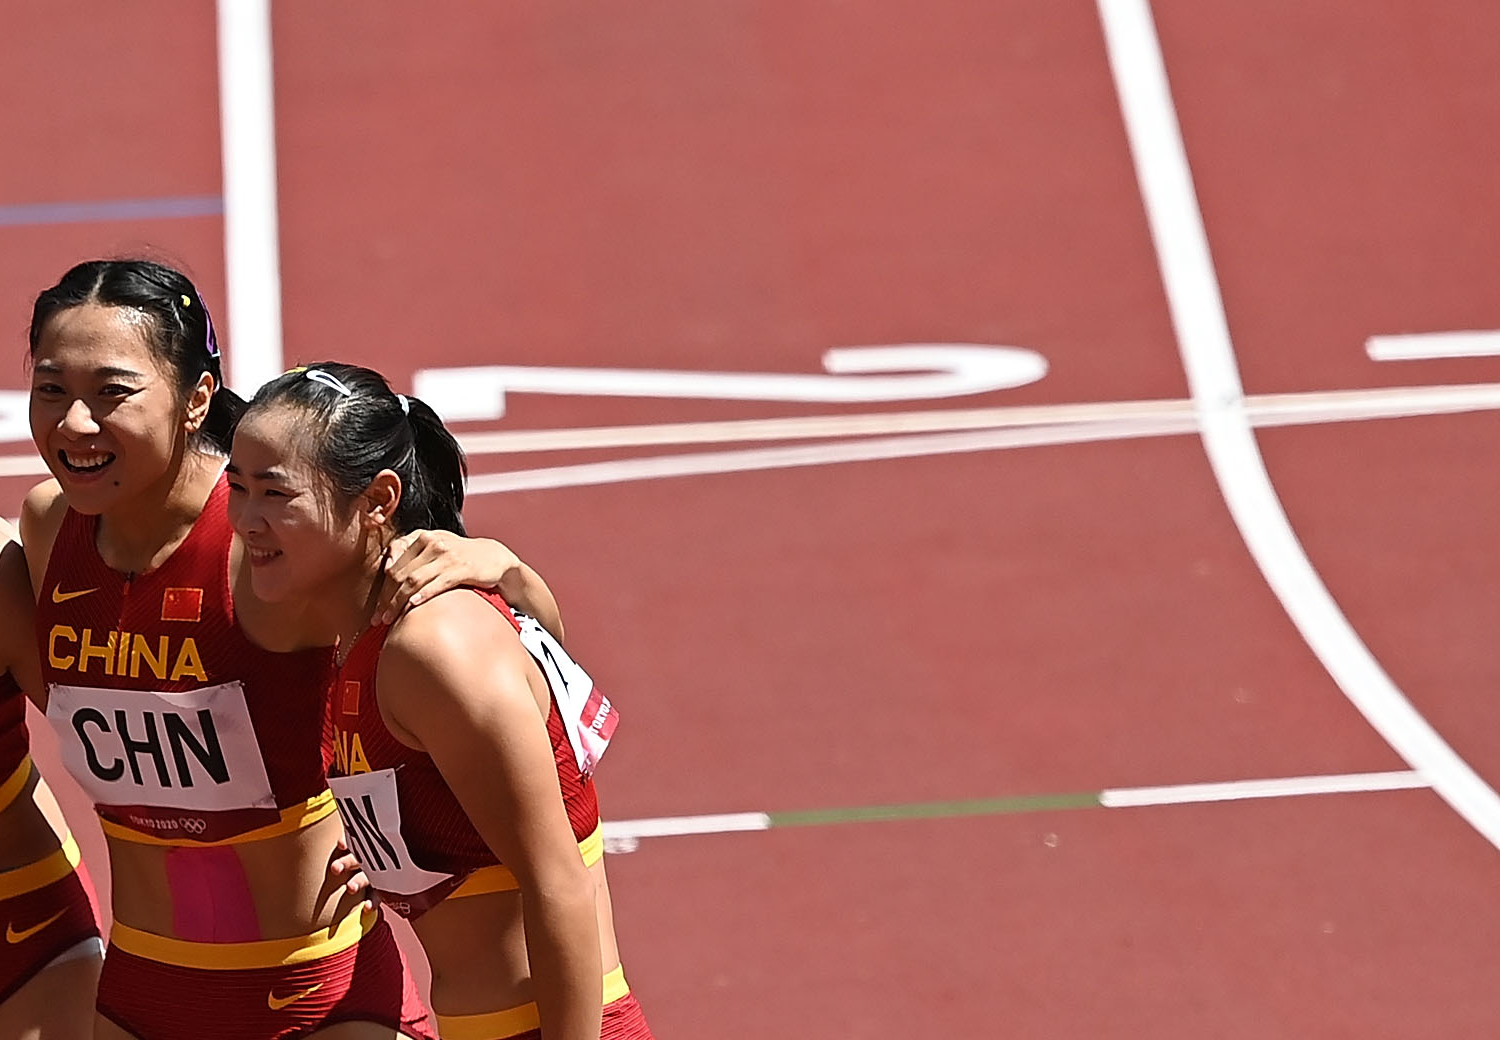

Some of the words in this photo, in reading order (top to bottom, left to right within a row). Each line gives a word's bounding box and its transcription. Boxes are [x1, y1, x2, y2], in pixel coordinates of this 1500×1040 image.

[49, 624, 209, 682] CHINA
[72, 707, 231, 788] CHN
[335, 794, 402, 871] HN
